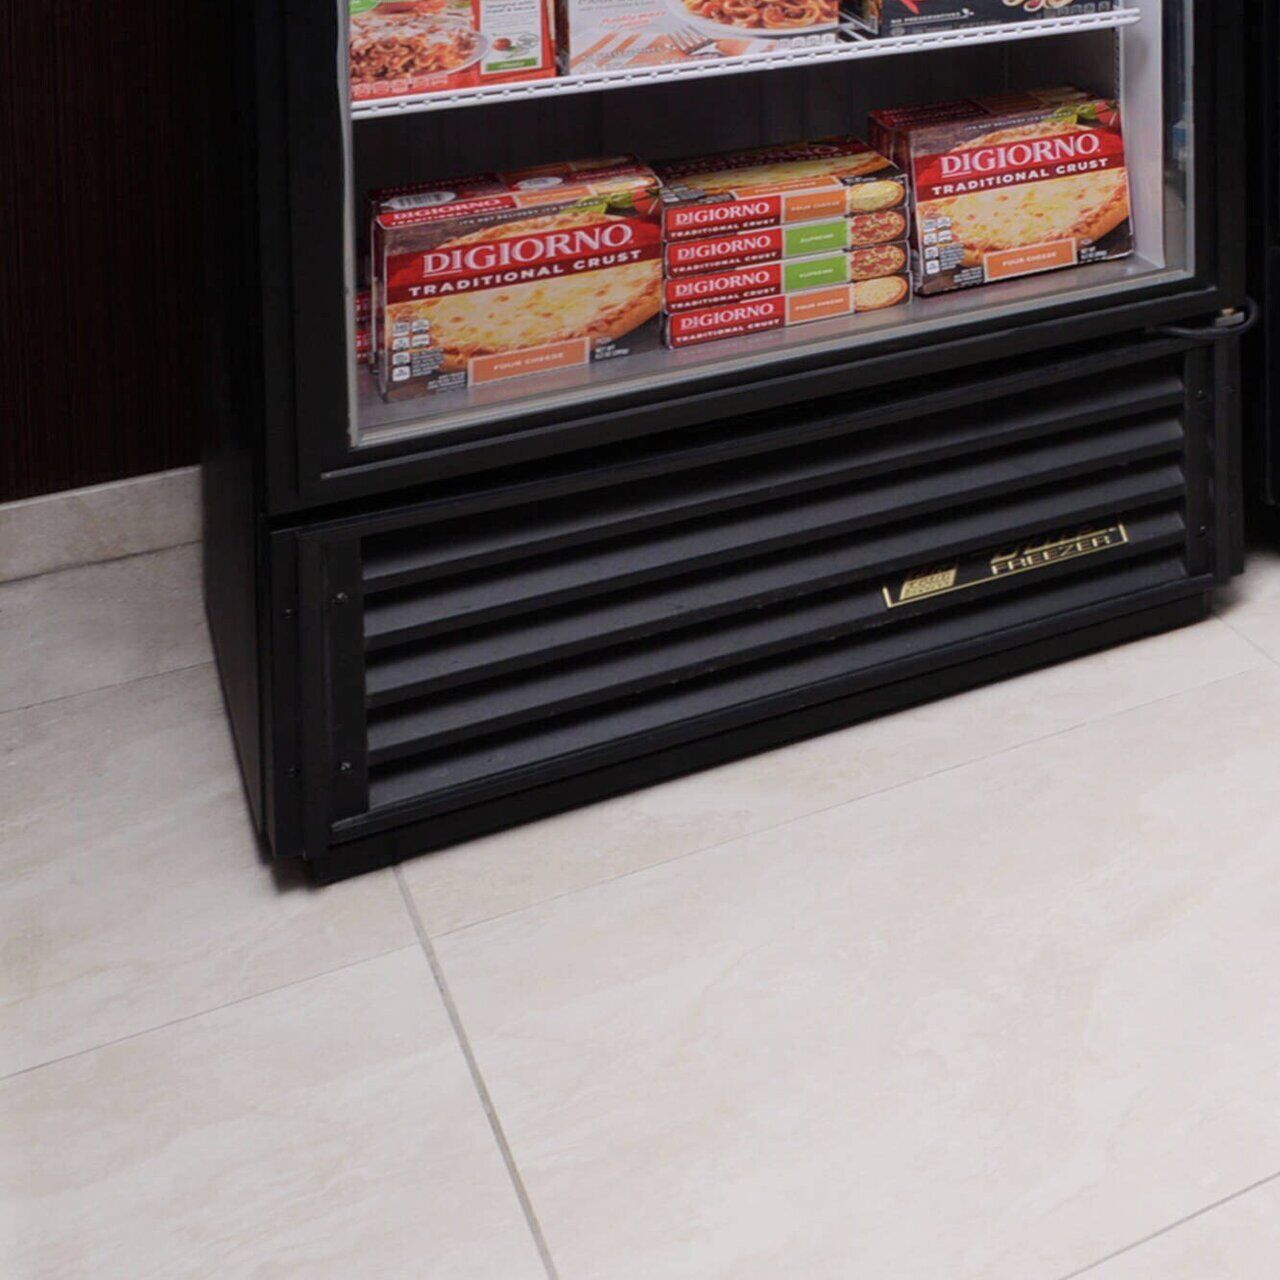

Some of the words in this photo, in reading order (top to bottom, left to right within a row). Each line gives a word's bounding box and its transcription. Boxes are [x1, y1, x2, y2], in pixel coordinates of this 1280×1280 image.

[931, 168, 1049, 196] TRADITIONAL
[1055, 158, 1109, 175] CRUST
[408, 264, 565, 297] TRADITIONAL
[573, 249, 643, 270] CRUST
[991, 528, 1115, 575] FREEZER
